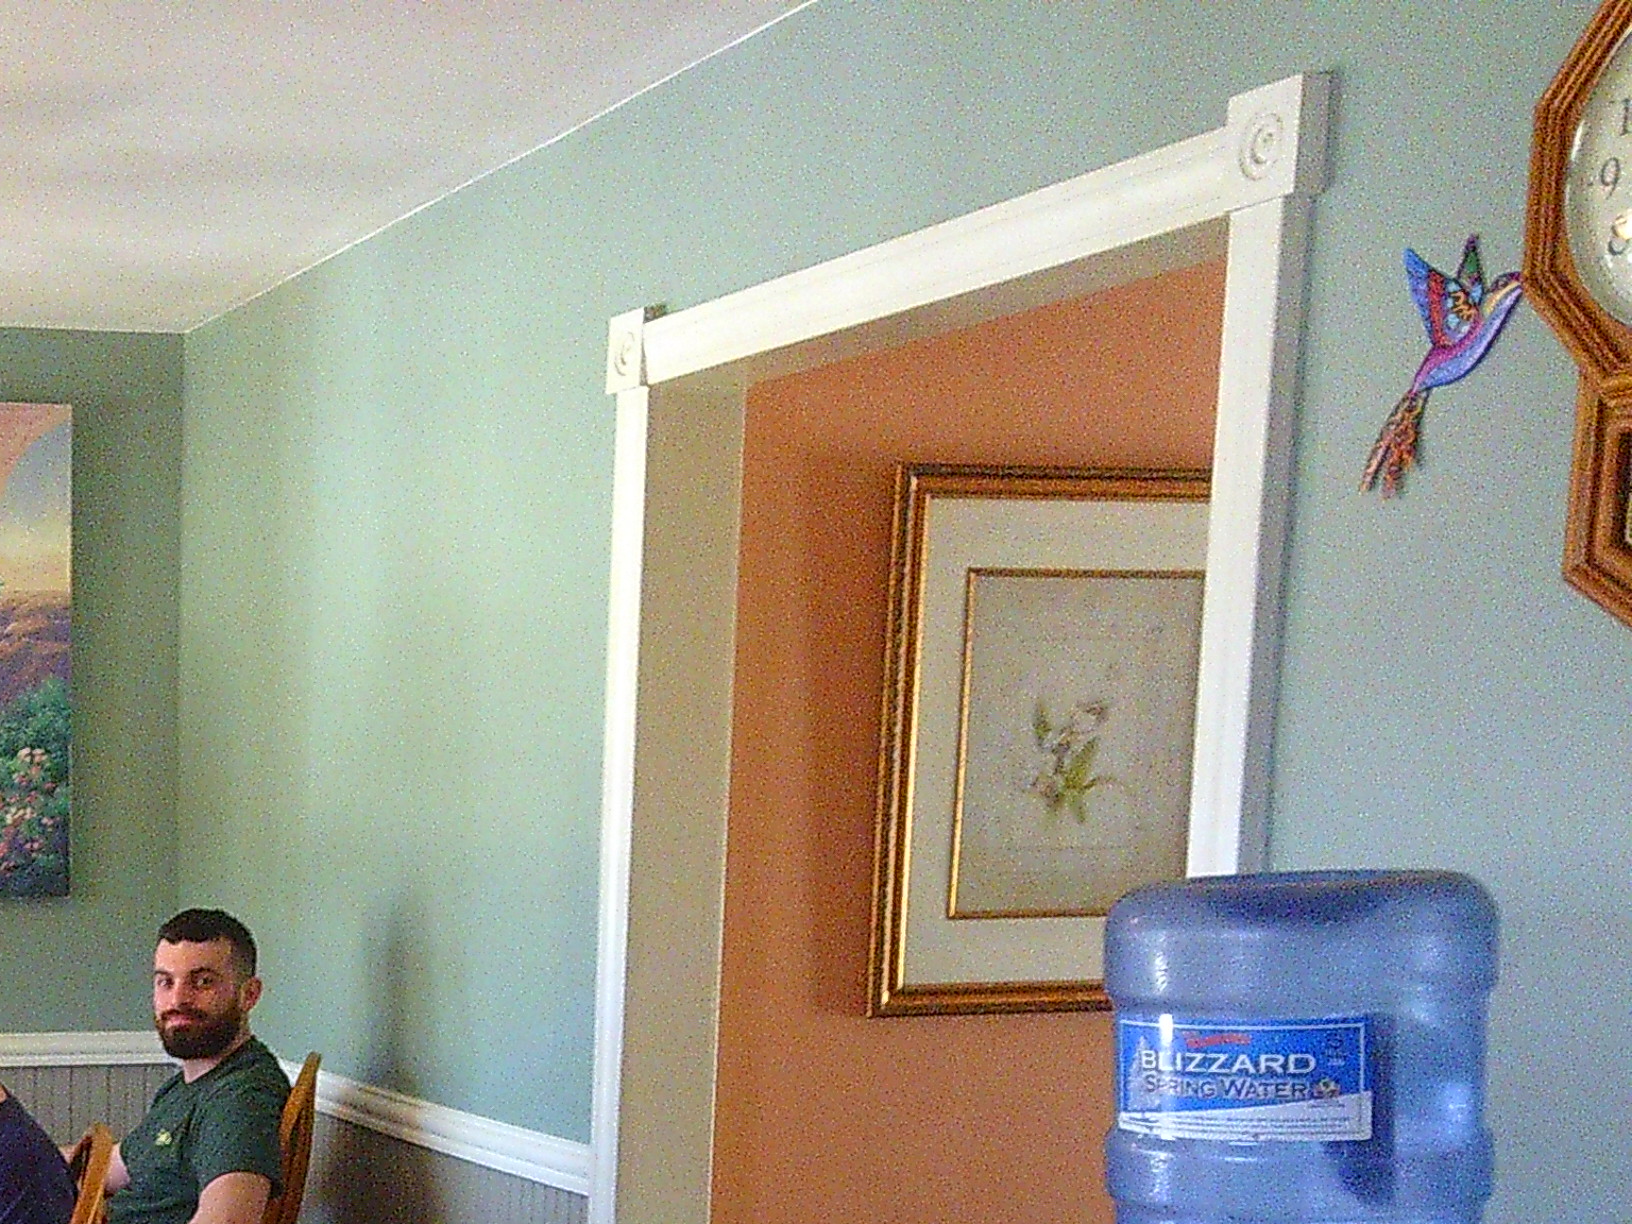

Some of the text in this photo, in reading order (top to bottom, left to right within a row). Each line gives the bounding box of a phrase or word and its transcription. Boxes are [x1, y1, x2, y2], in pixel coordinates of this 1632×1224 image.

[1600, 157, 1621, 200] 9
[1141, 1050, 1317, 1074] BLIZZARD
[1144, 1072, 1311, 1100] SPRING WATER
